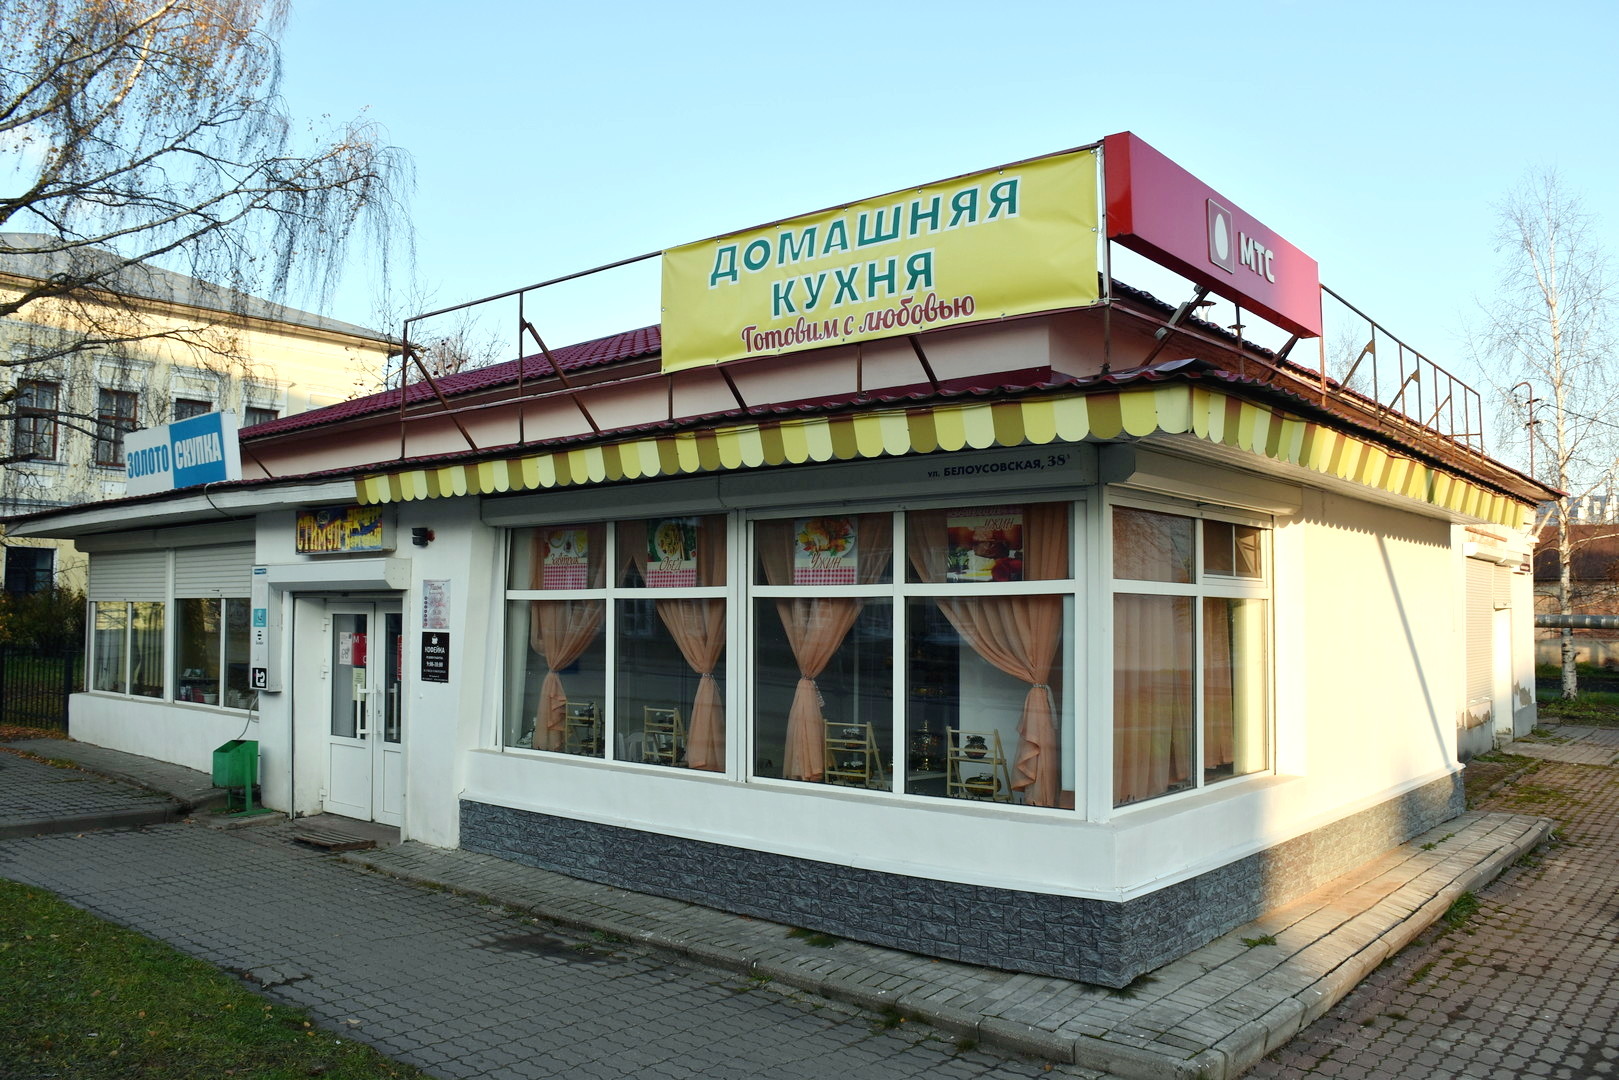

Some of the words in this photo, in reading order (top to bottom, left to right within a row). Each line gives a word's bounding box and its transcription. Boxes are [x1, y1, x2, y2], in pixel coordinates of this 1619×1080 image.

[709, 177, 1020, 288] ДОМАШНЯЯ
[1239, 231, 1275, 284] МТС
[772, 249, 934, 318] КУХНЯ
[741, 317, 839, 353] Готовим
[843, 316, 855, 336] с
[859, 293, 975, 332] любовью
[127, 444, 169, 479] ЗОЛОТО
[174, 432, 223, 470] СКУПКА
[928, 470, 940, 478] ул.
[943, 459, 1044, 477] БЕЛОУСОВСКАЯ,
